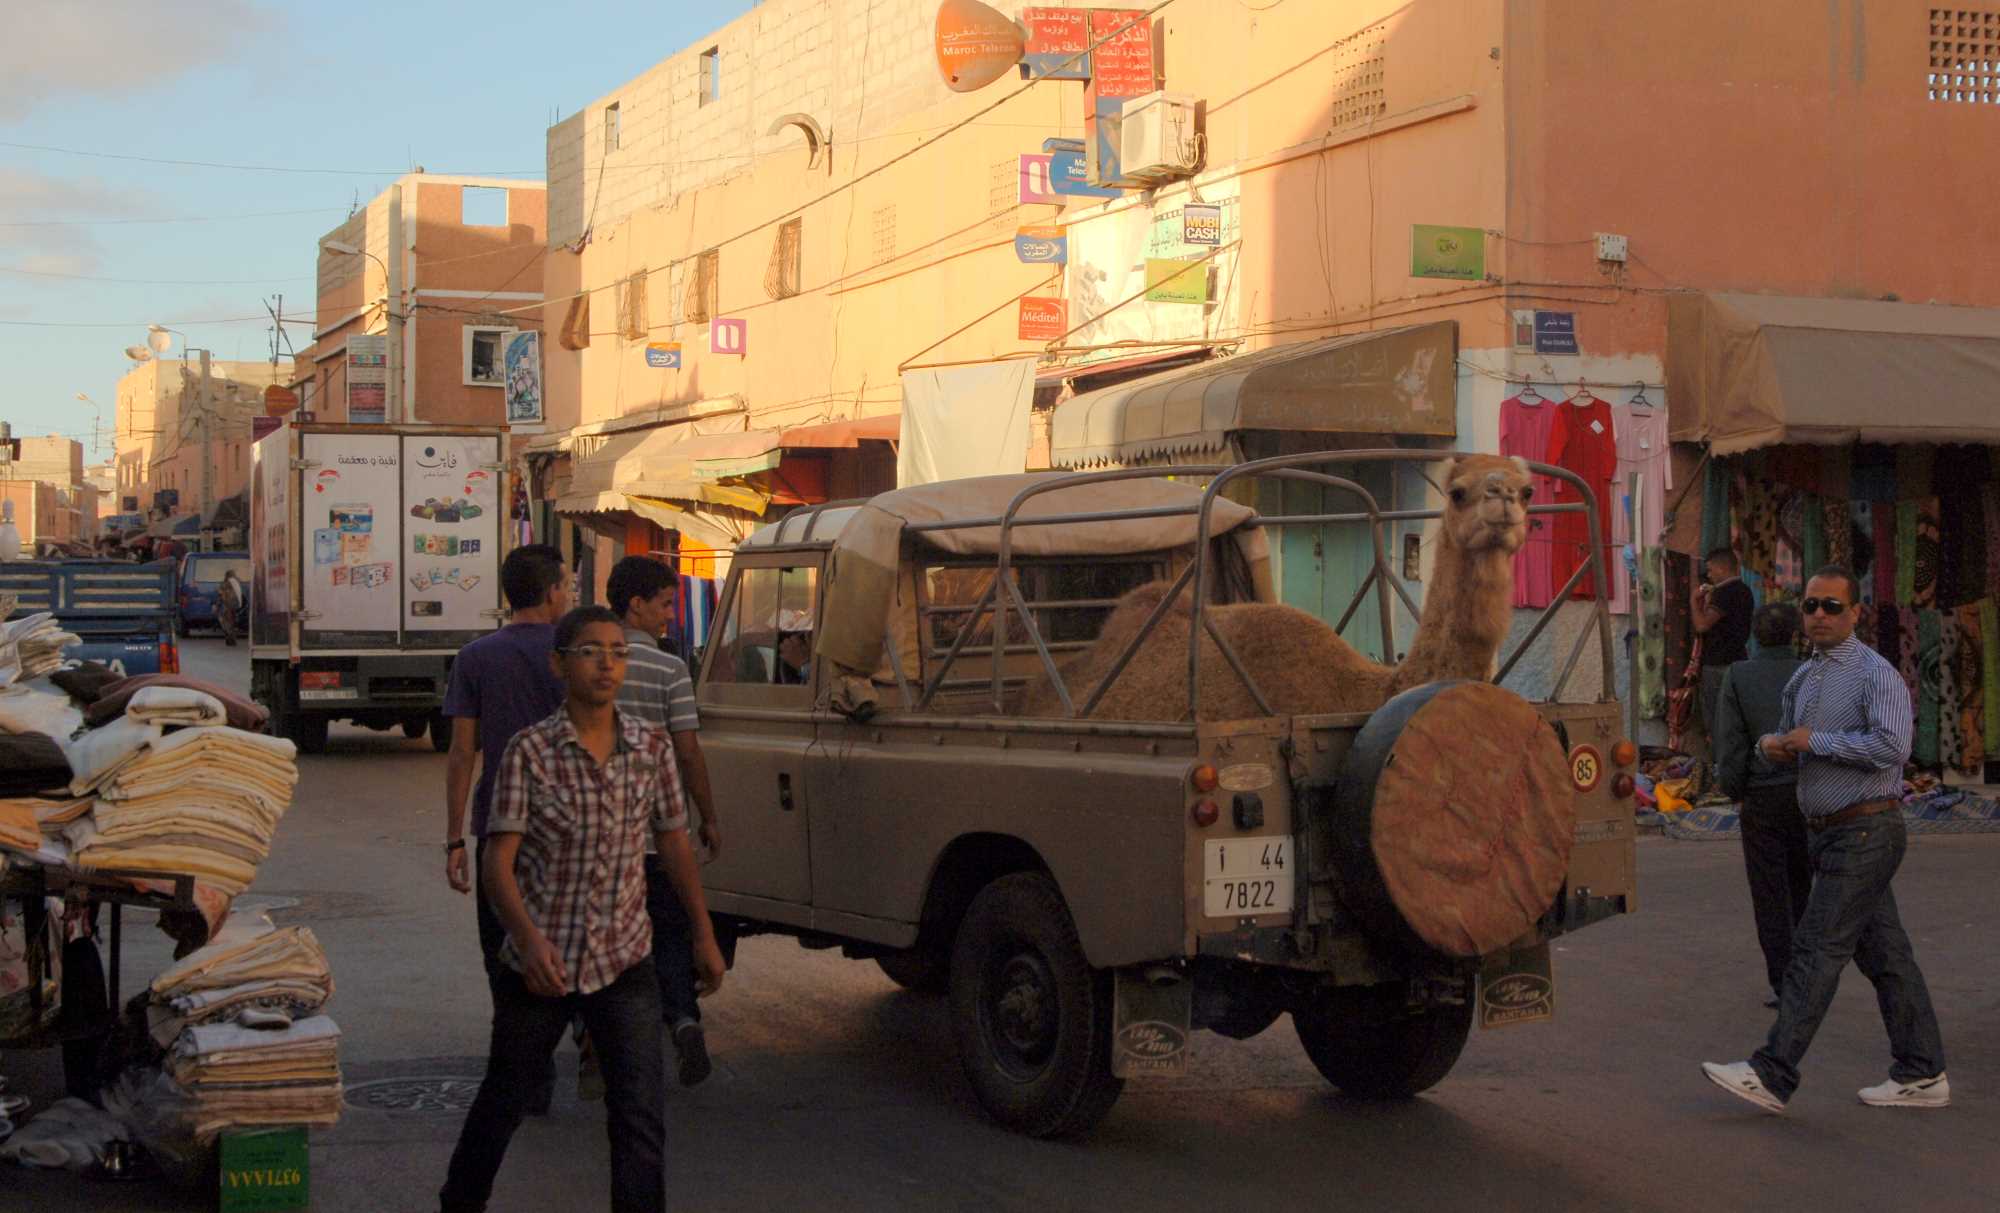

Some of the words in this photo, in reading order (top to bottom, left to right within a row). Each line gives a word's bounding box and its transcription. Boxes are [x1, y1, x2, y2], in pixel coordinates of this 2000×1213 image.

[1186, 216, 1219, 228] MOBI
[1185, 227, 1219, 239] CASH
[1022, 311, 1060, 323] Méditel
[1576, 759, 1592, 781] 85
[1260, 844, 1284, 870] 44
[1224, 880, 1275, 910] 7822
